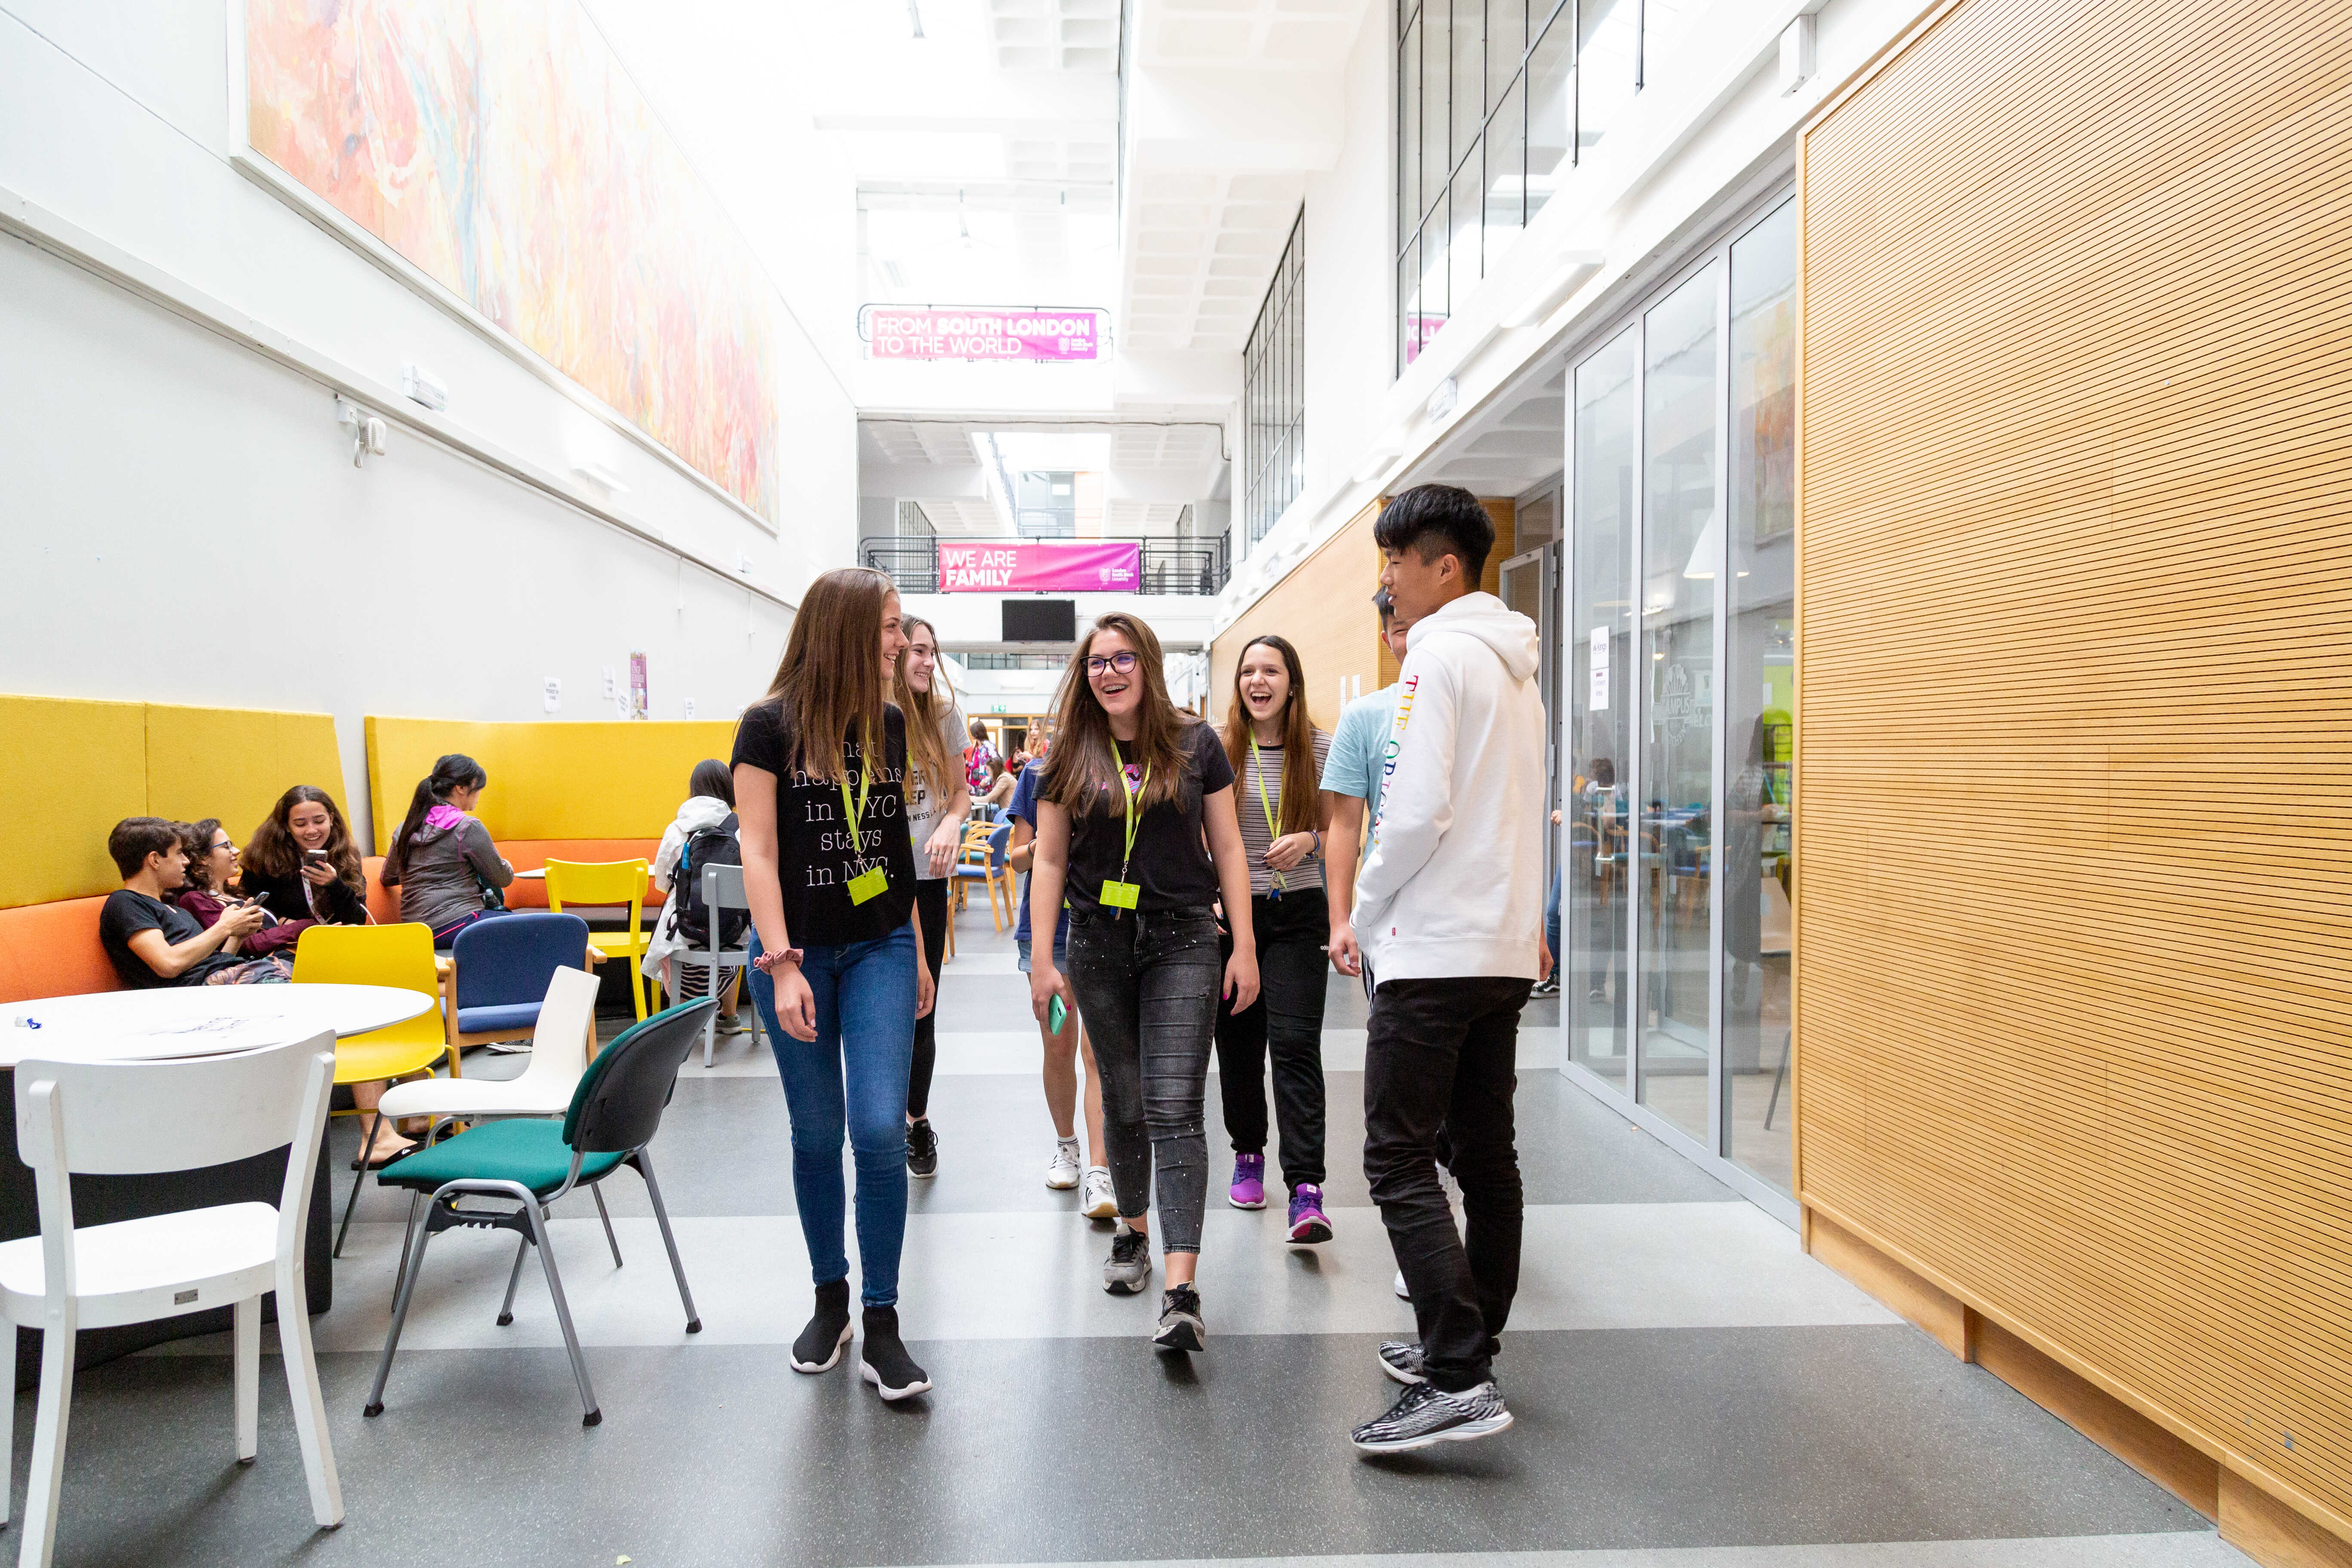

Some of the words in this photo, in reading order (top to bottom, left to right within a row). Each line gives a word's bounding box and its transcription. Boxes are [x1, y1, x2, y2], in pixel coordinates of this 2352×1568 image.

[878, 318, 930, 334] FROM
[937, 317, 1001, 335] SOUTH
[1007, 319, 1090, 336] LONDON
[878, 337, 903, 353] TO
[908, 337, 944, 353] THE
[949, 337, 1022, 354] WORLD
[946, 550, 976, 567] WE
[981, 550, 1017, 567] ARE
[946, 569, 1013, 586] FAMILY
[805, 801, 835, 822] in
[821, 829, 882, 853] stays
[806, 865, 835, 887] in
